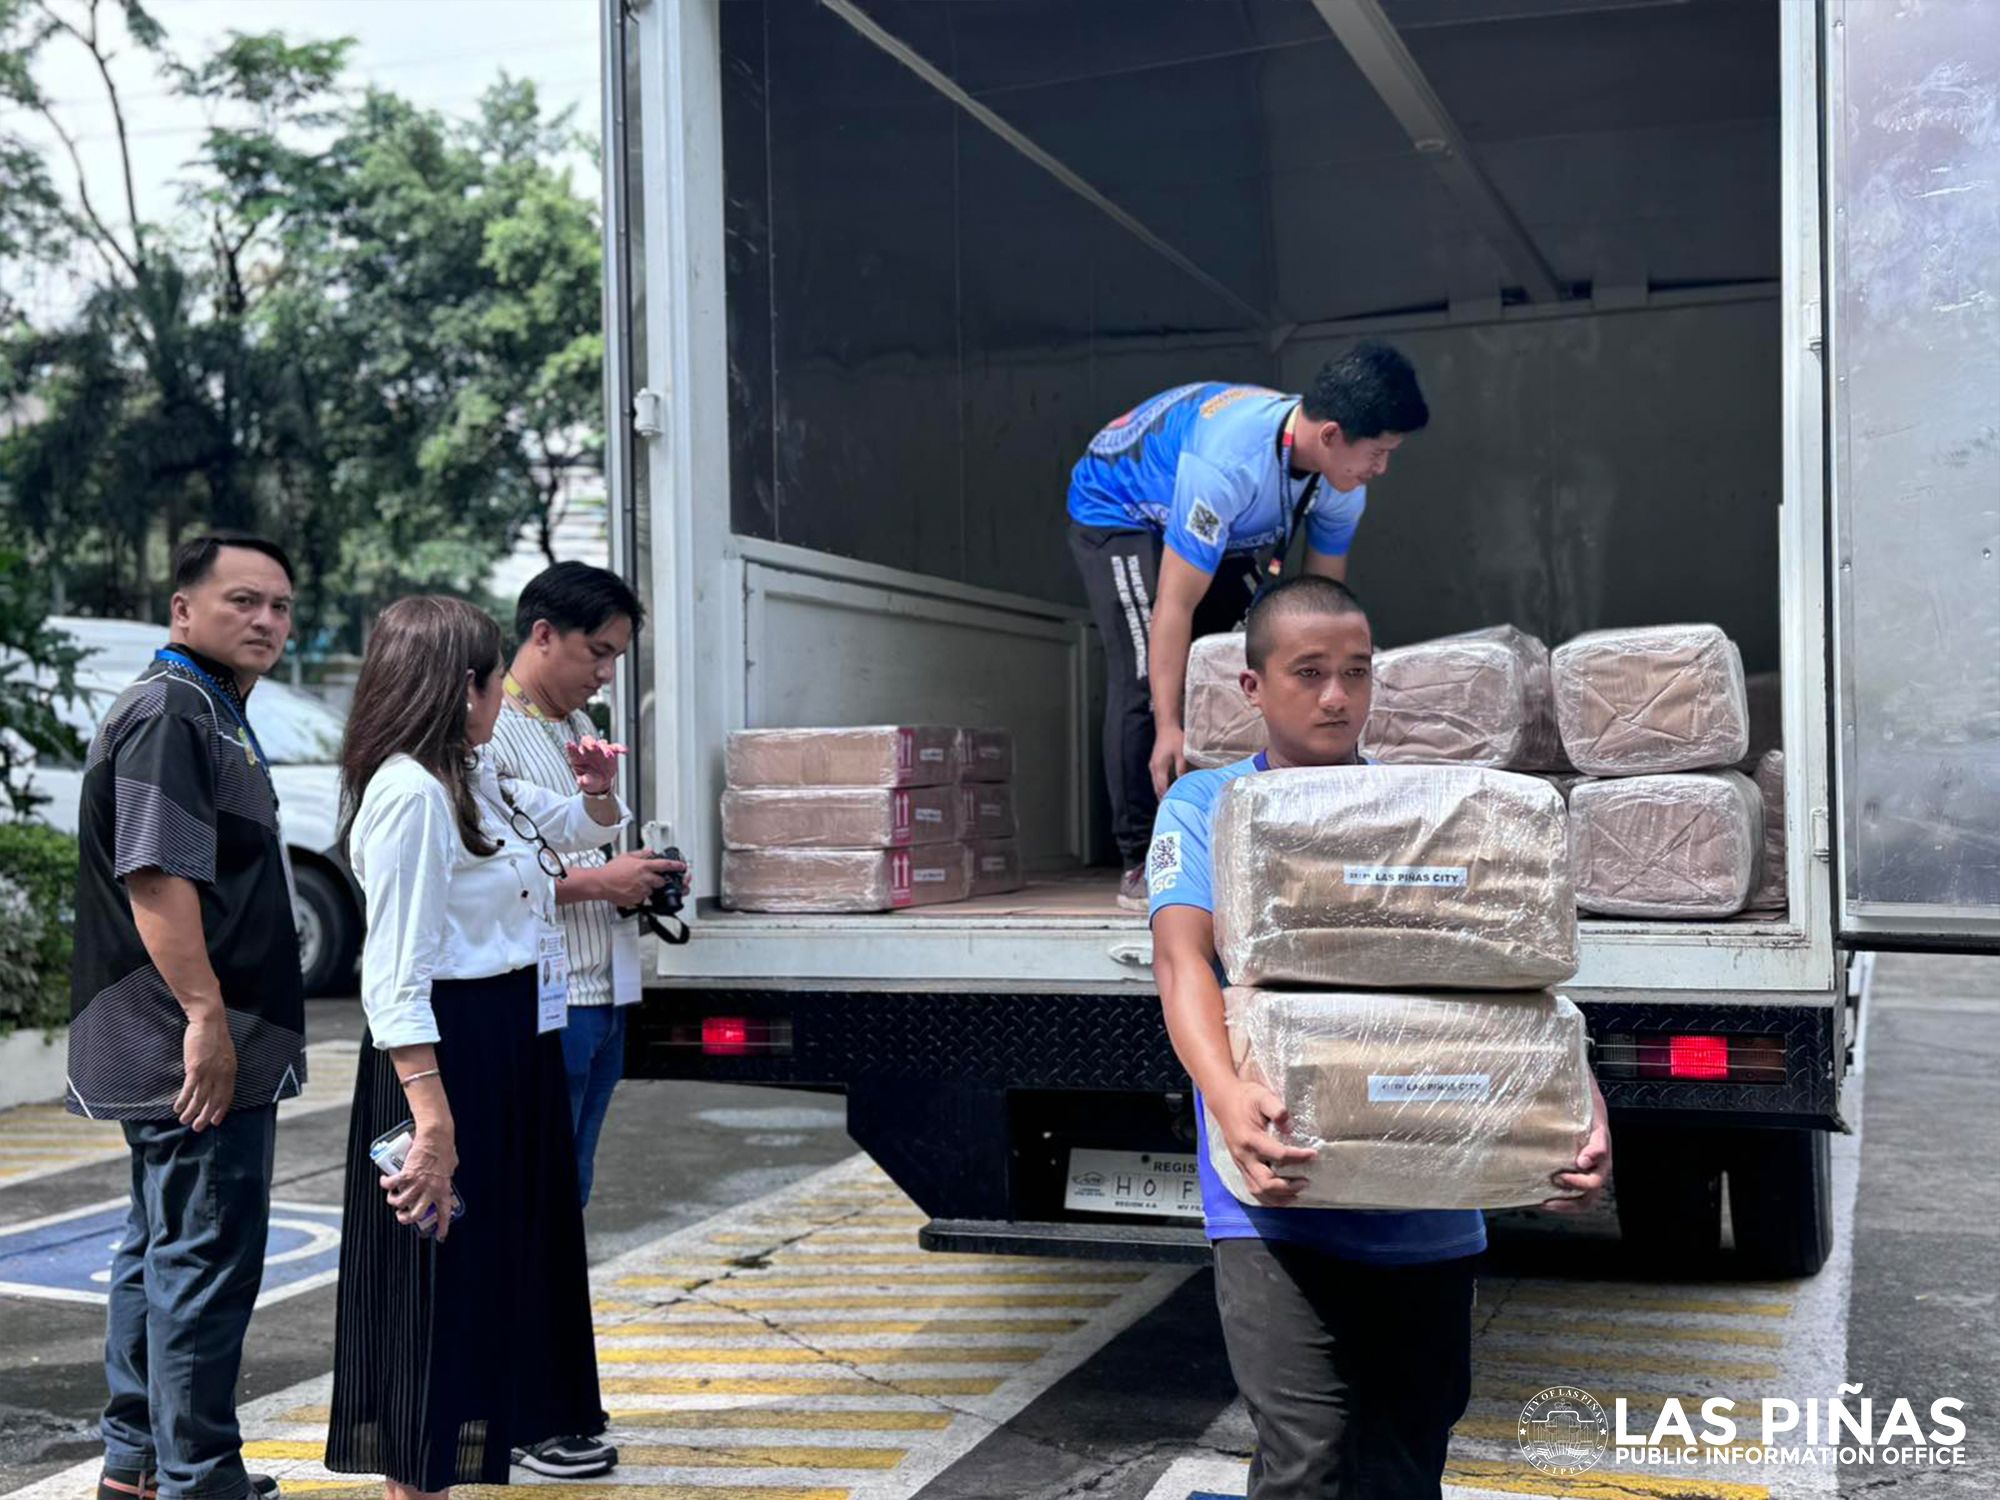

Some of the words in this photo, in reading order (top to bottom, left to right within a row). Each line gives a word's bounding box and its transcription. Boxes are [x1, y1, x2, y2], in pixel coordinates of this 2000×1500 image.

[1375, 873, 1395, 881] LAS
[1398, 871, 1430, 882] PIÑAS
[1433, 873, 1459, 882] CITY
[1153, 1161, 1198, 1173] REGIS
[1116, 1176, 1131, 1196] H
